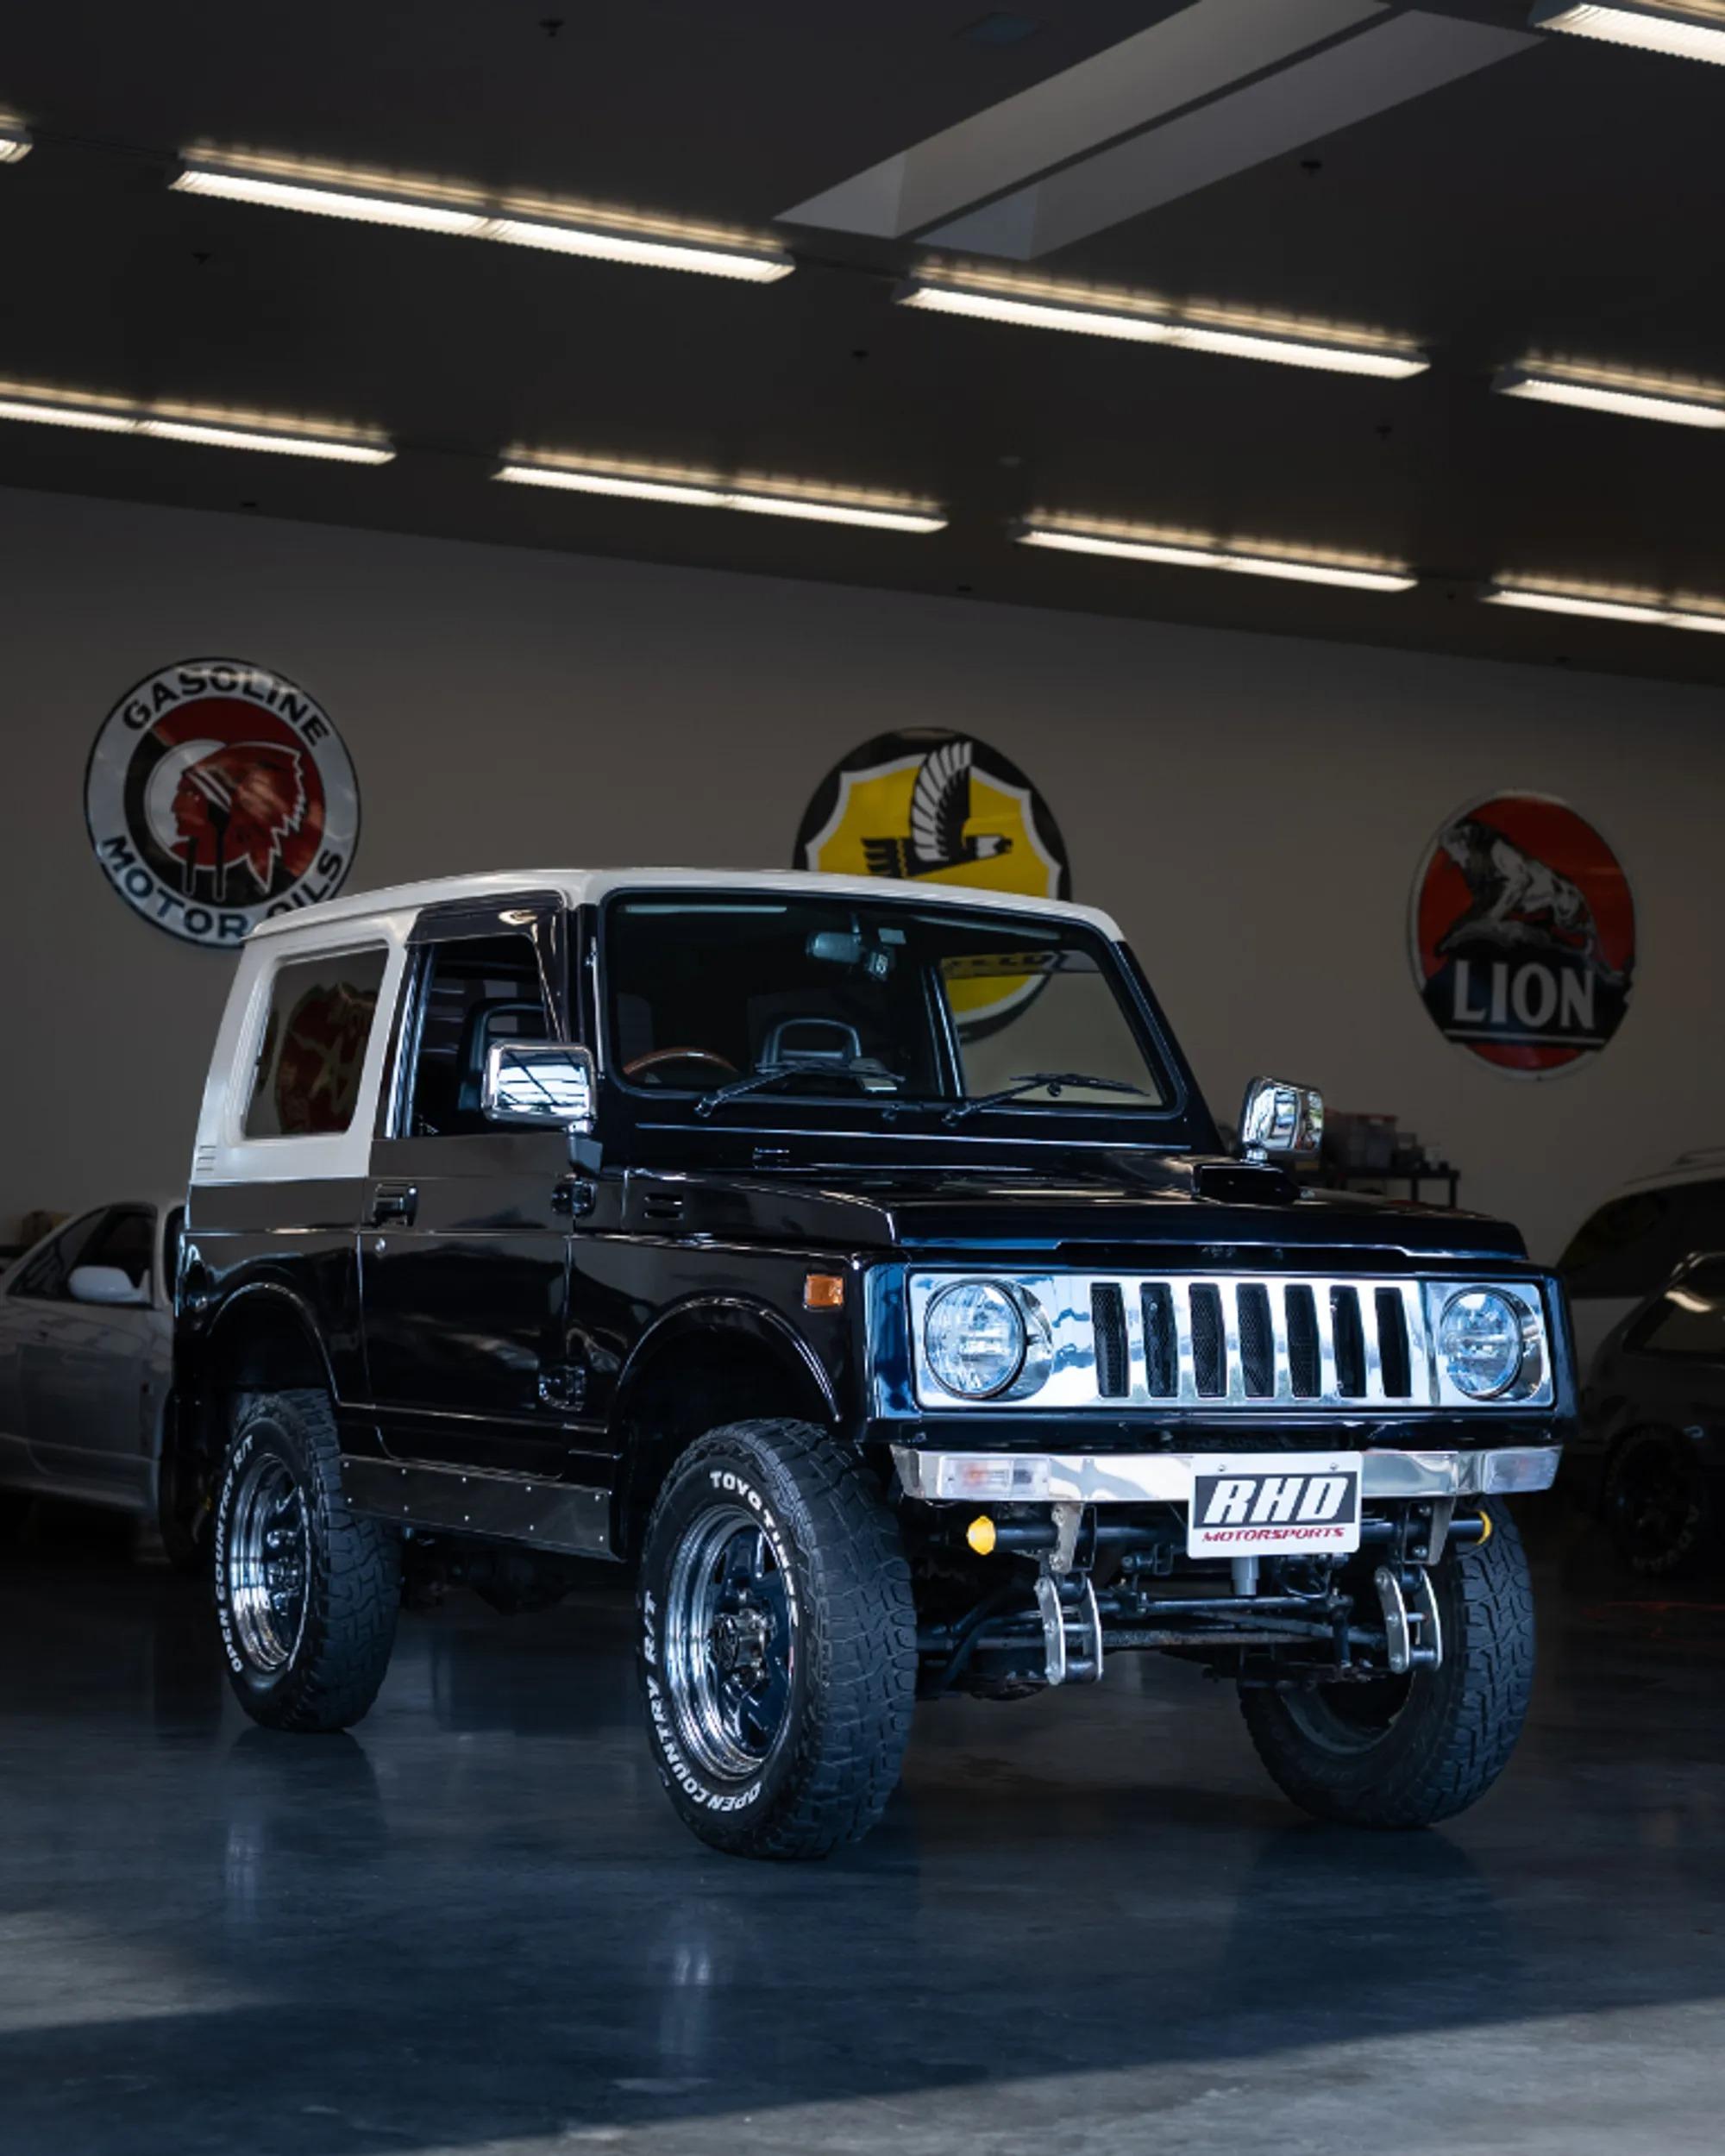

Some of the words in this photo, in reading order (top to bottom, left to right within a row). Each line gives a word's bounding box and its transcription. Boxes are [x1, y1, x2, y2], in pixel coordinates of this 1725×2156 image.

[122, 667, 329, 747] GASOLINE
[102, 836, 248, 938] MOTOR
[1453, 959, 1595, 1030] LION
[709, 1470, 763, 1511] TOYO
[1202, 1476, 1349, 1525] RHD
[1202, 1526, 1346, 1543] MOTORSPORTS
[646, 1673, 708, 1804] COUNTRY
[706, 1780, 762, 1812] OPEN
